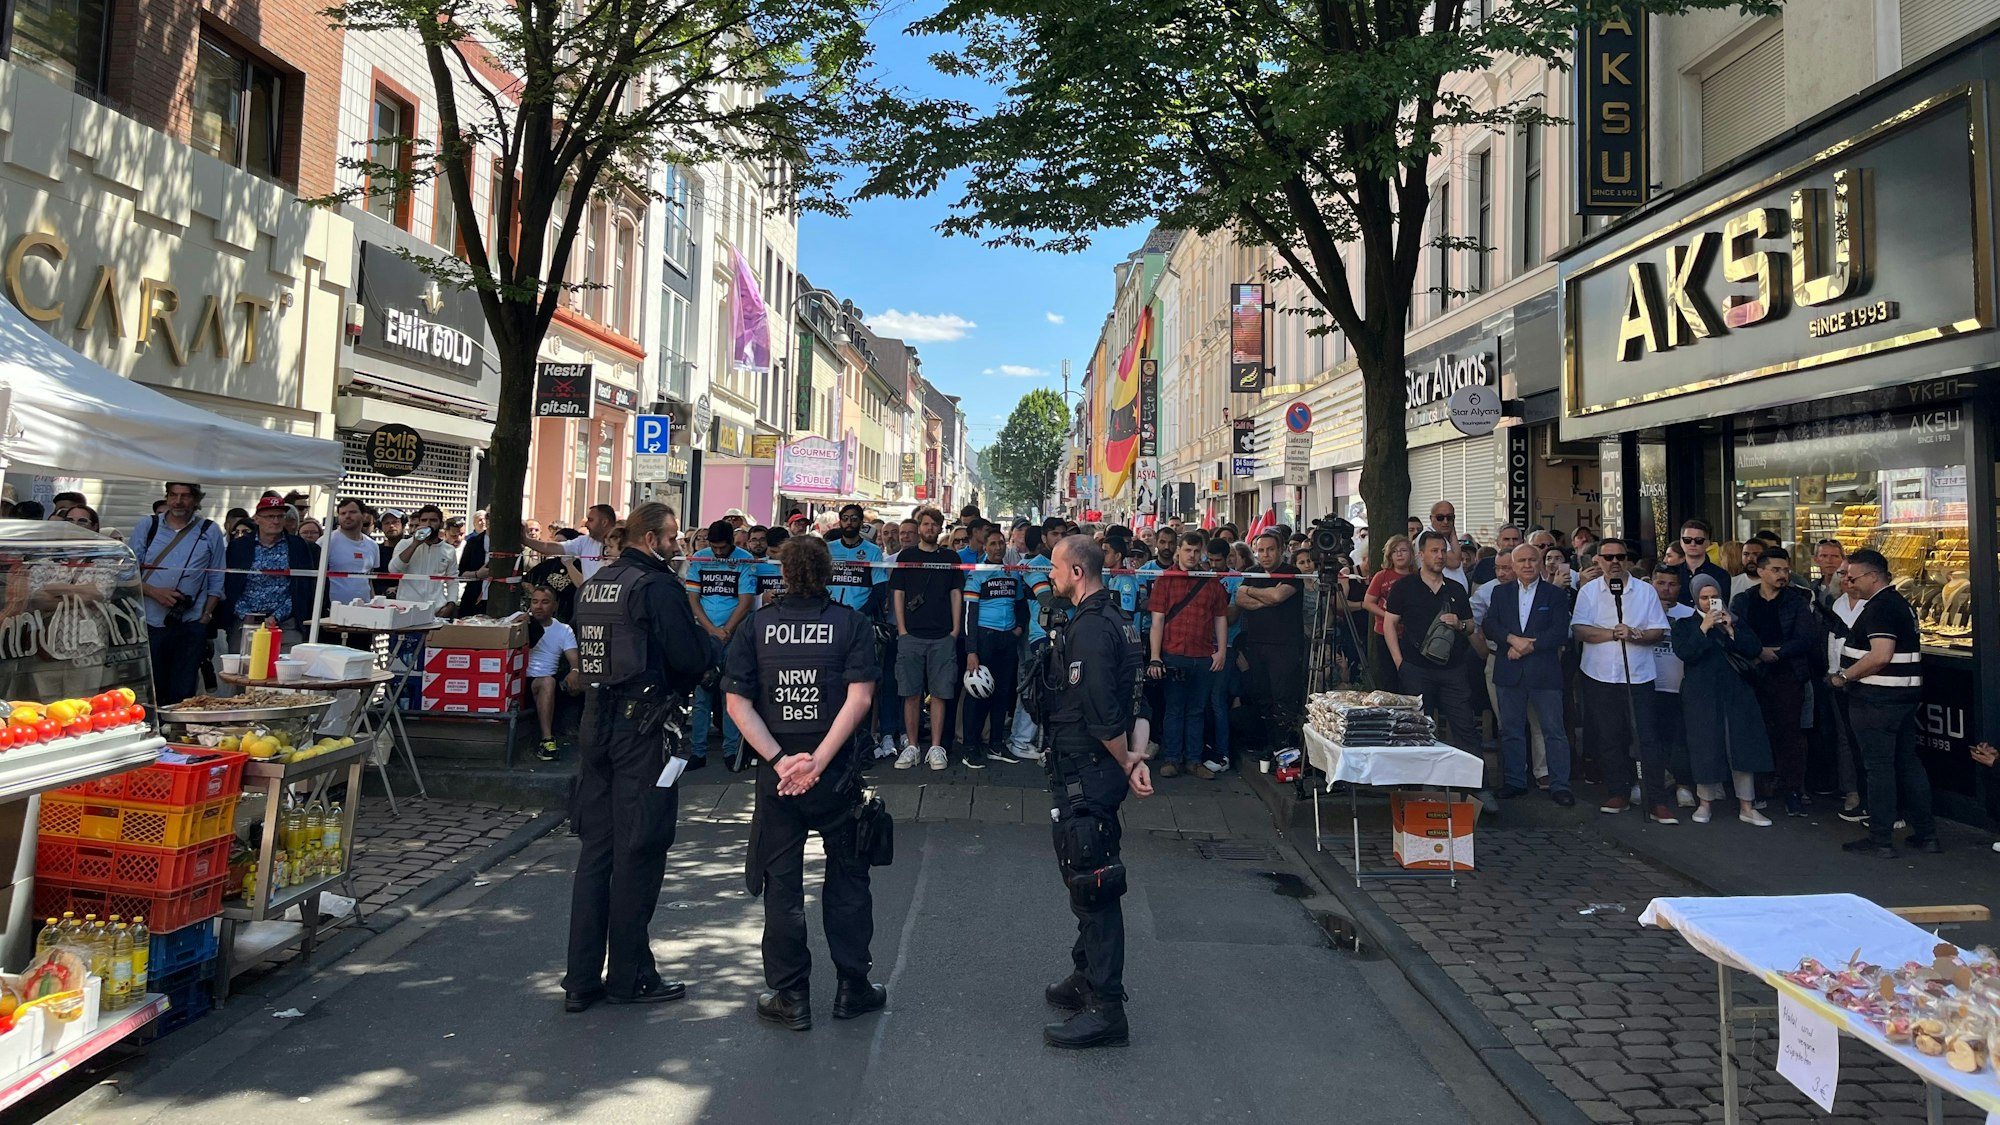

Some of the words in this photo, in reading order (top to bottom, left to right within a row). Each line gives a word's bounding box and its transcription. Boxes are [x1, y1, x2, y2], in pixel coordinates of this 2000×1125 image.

[1598, 5, 1633, 184] AKSU
[1592, 189, 1615, 197] SINCE
[1617, 189, 1638, 197] 1993
[1616, 168, 1852, 362] AKSU
[5, 231, 274, 368] CARAT
[1850, 301, 1888, 327] 1993
[430, 325, 473, 367] GOLD
[543, 364, 586, 377] Kestir
[1405, 369, 1429, 410] Star
[1431, 351, 1487, 402] Alyans
[1452, 408, 1468, 416] Star
[1470, 407, 1500, 417] Alyans
[1910, 410, 1960, 436] AKSU
[643, 420, 662, 450] P
[1935, 434, 1951, 443] 1993
[373, 446, 416, 461] GOLD
[792, 446, 838, 459] GOURMET
[795, 473, 831, 485] STÜBLE
[1639, 481, 1667, 497] ATASAY
[702, 573, 736, 583] MUSLIME
[832, 574, 863, 583] FRIEDEN
[987, 580, 1015, 588] MUSLIME
[580, 584, 622, 603] POLIZEI
[989, 588, 1016, 596] FRIEDEN
[582, 626, 604, 640] NRW
[764, 624, 834, 645] POLIZEI
[580, 642, 605, 657] 31423
[582, 659, 603, 674] BeSi
[778, 669, 817, 686] NRW
[775, 687, 820, 703] 31422
[783, 704, 818, 721] BeSi
[1927, 737, 1951, 751] 1993
